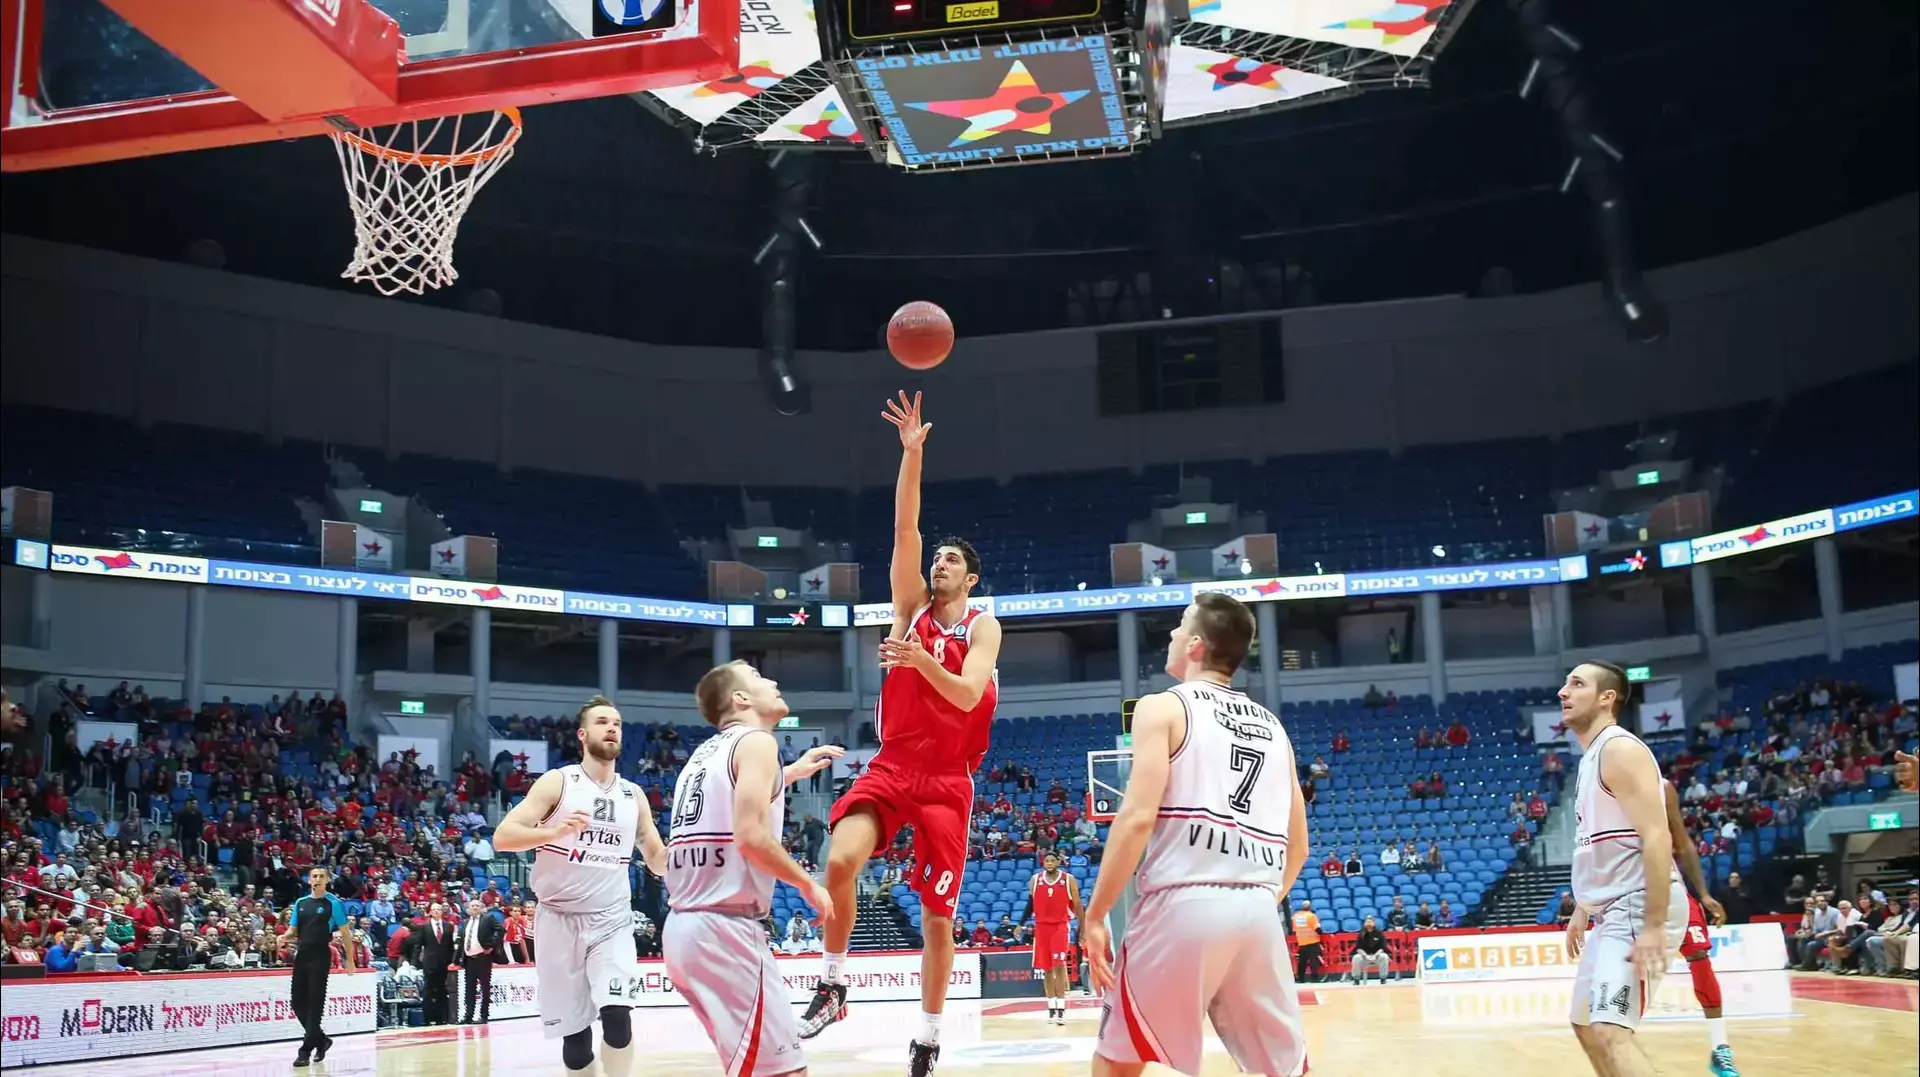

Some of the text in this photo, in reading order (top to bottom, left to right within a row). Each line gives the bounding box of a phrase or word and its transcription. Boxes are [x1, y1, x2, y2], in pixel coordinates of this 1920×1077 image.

[951, 5, 995, 20] Bodet
[994, 36, 1105, 59] ירושלים
[906, 146, 1004, 164] ירושלים
[1839, 498, 1914, 526] בצומת
[1782, 519, 1827, 537] צומת
[148, 561, 202, 576] צומת
[214, 567, 292, 585] בצומת
[1425, 569, 1489, 584] לעצור
[1495, 567, 1546, 581] כדאי
[298, 573, 368, 591] לעצור
[1296, 581, 1339, 593] צומת
[1351, 576, 1419, 591] בצומת
[416, 584, 558, 606] צומת ספרים
[1072, 591, 1131, 607] לעצור
[1136, 589, 1185, 603] כדאי
[569, 598, 632, 614] בצומת
[637, 603, 694, 619] לעצור
[999, 598, 1064, 612] בצומת
[854, 610, 895, 621] פרים
[933, 637, 946, 664] 8
[1228, 743, 1265, 815] 7
[671, 766, 707, 830] 13
[593, 797, 616, 823] 21
[578, 828, 622, 847] rytas
[1188, 823, 1284, 871] VILNIUS
[934, 870, 954, 896] 8
[1047, 887, 1054, 898] 9
[1688, 925, 1707, 944] 15
[910, 970, 972, 986] מסה
[60, 999, 154, 1038] MODERN
[161, 1000, 212, 1030] ישראל
